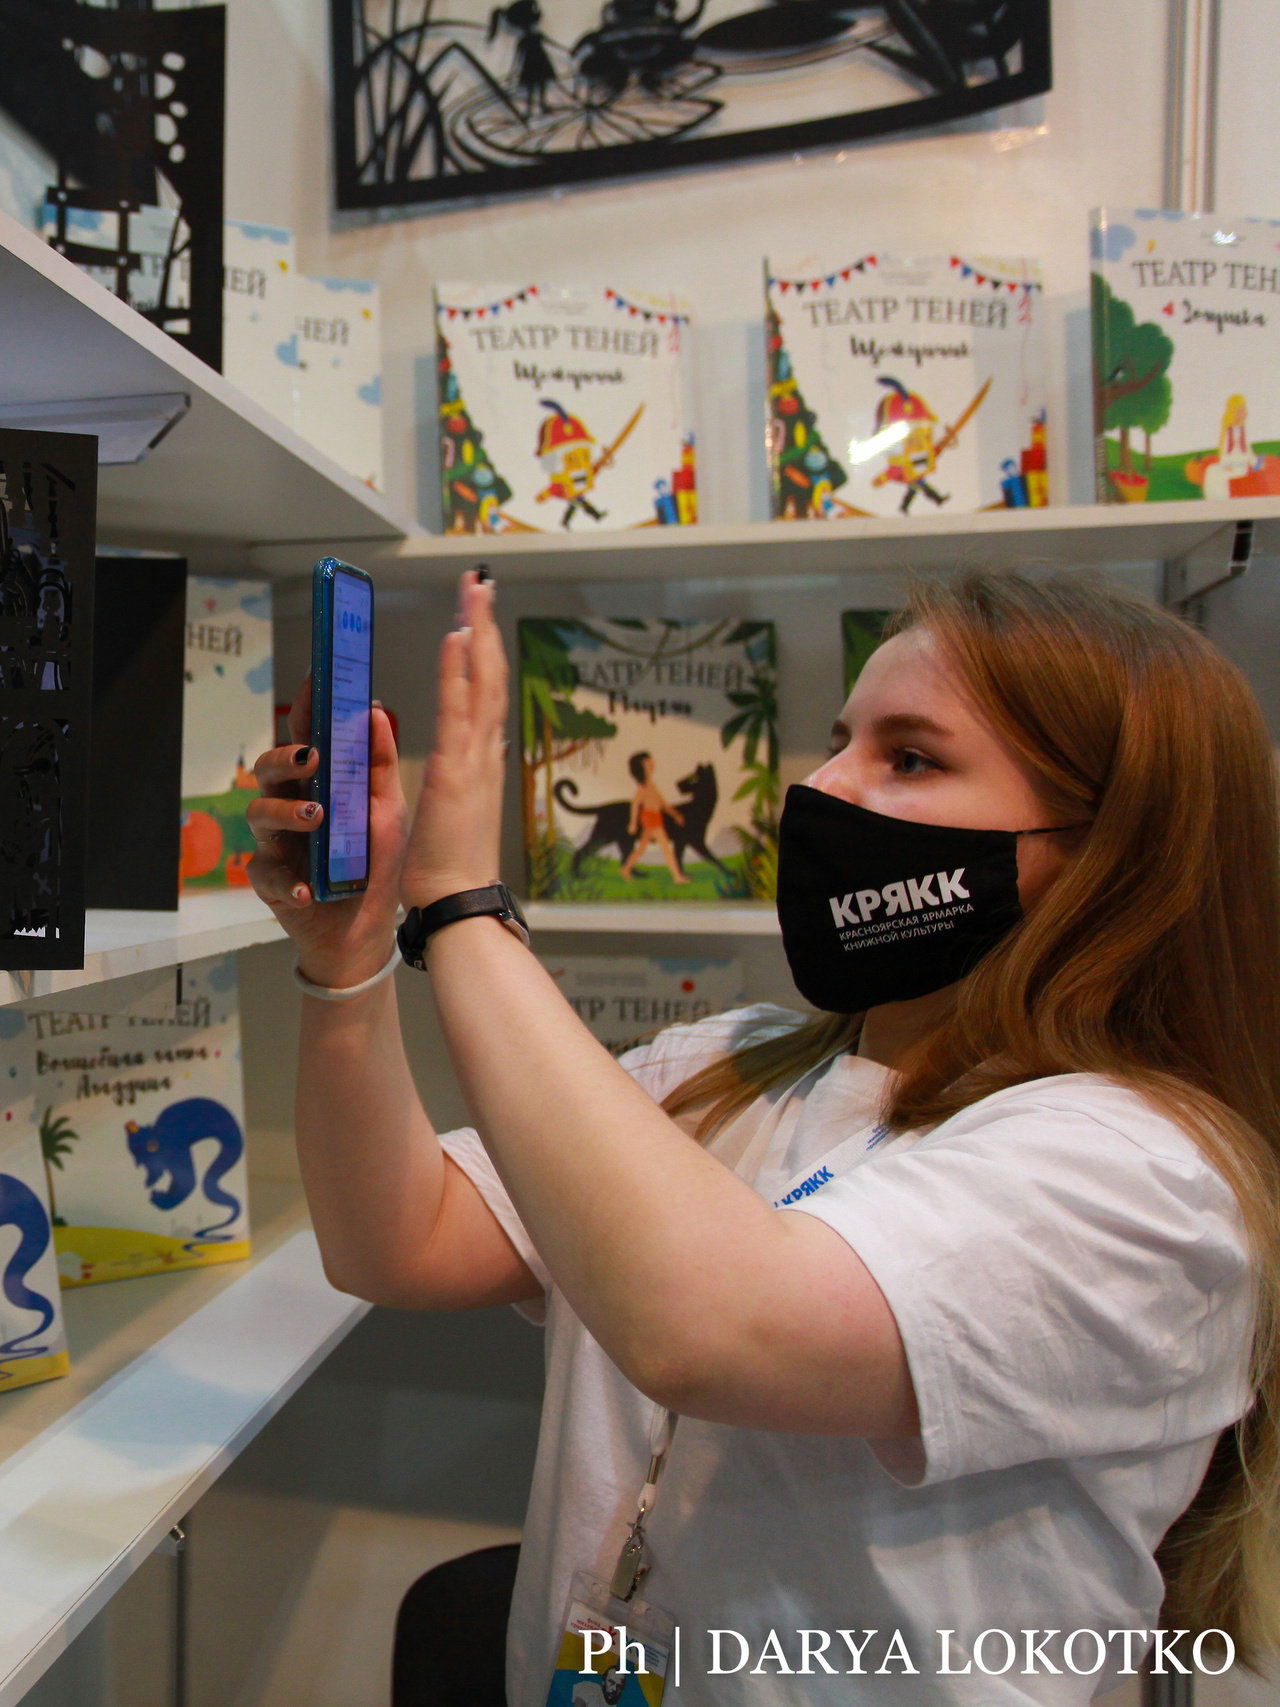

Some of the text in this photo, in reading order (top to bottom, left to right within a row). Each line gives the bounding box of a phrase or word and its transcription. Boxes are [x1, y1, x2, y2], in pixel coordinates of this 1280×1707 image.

[1131, 259, 1217, 288] ТЕАТР
[802, 297, 1008, 330] ТЕАТР ТЕНЕЙ
[469, 324, 659, 358] ТЕАТР ТЕНЕЙ
[829, 867, 970, 928] КРЯКК
[839, 902, 975, 942] КРАСНОЯРСКАЯ ЯРМАРКА
[843, 920, 955, 952] КНИЖНОЙ КУЛЬТУРЫ
